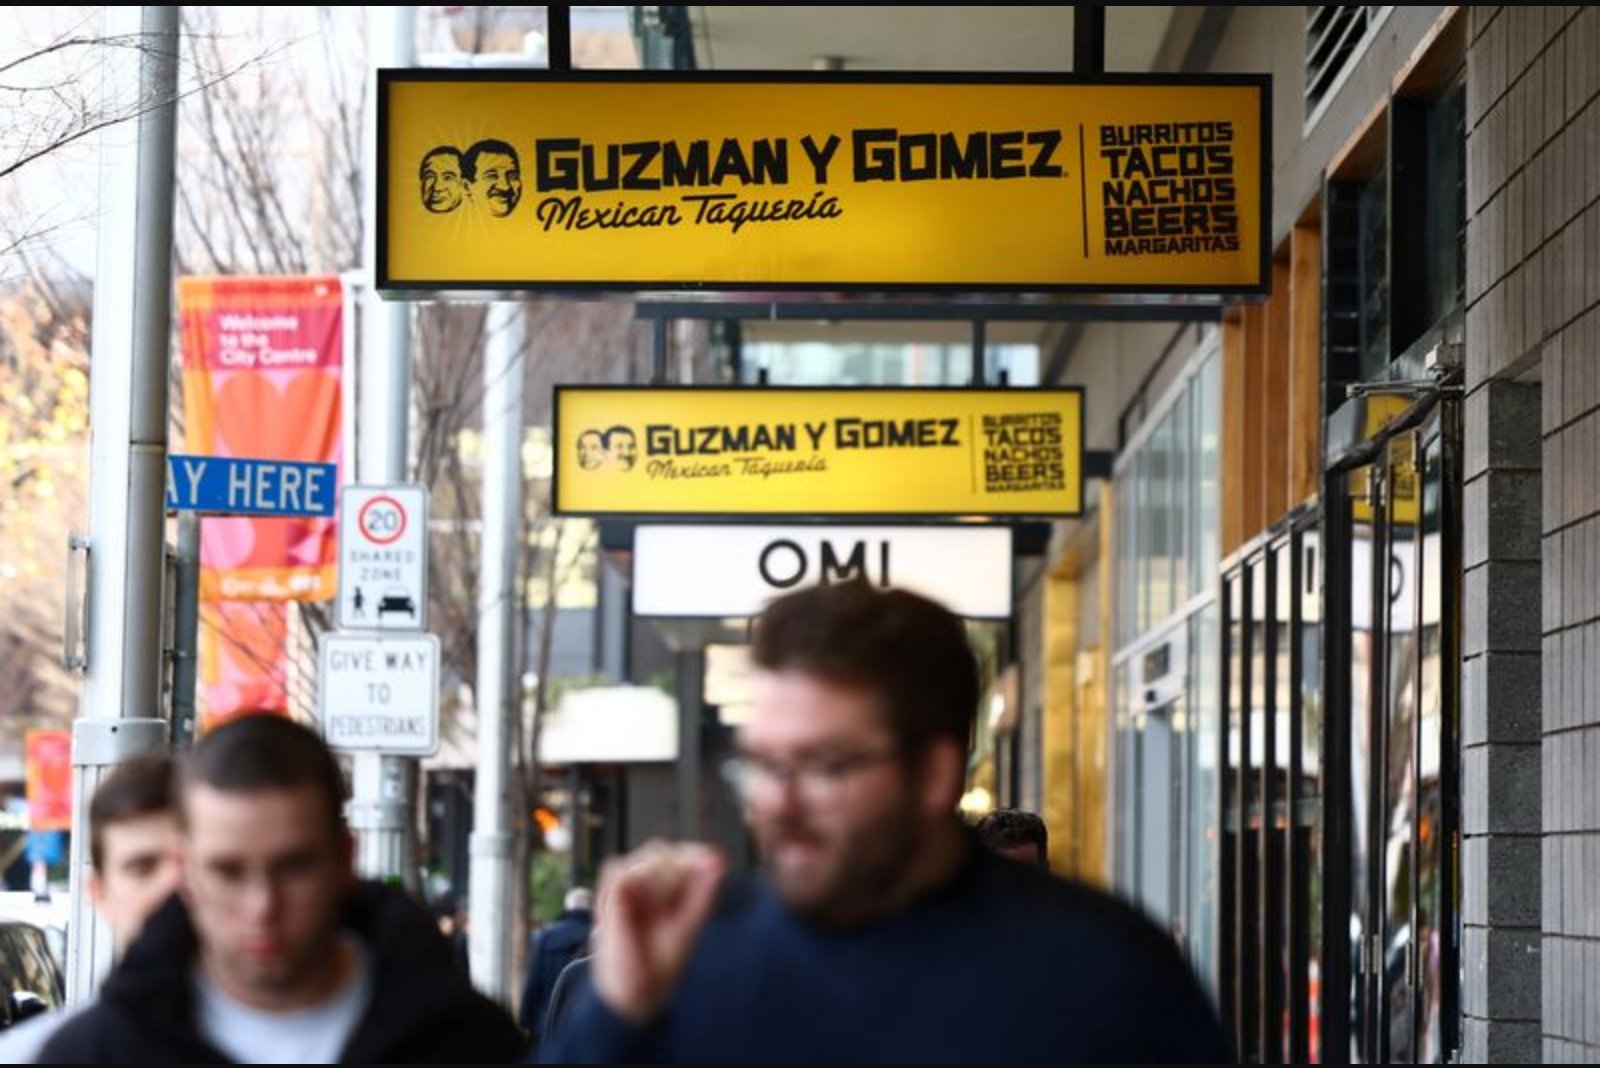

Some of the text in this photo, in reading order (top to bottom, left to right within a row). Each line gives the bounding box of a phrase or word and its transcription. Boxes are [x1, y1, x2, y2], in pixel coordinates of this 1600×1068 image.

[1100, 122, 1233, 146] BURRITOS
[535, 128, 1063, 192] GUZMAN Y GOMEZ
[1101, 145, 1233, 179] TACOS
[1103, 178, 1236, 206] NACHOS
[536, 196, 682, 232] Mexican
[1104, 205, 1239, 238] BEERS
[1104, 235, 1240, 257] MARGARITAS
[220, 314, 298, 331] Welcome
[220, 332, 269, 348] to the
[221, 349, 317, 366] City Centre
[646, 418, 960, 456] GUZMAN Y GOMEZ
[983, 427, 1063, 447] TACOS
[984, 447, 1064, 464] NACHOS
[985, 463, 1065, 482] BEERS
[228, 463, 325, 511] HERE
[369, 509, 398, 532] 20
[351, 551, 415, 563] SHARED
[361, 567, 401, 581] ZONE
[330, 650, 427, 671] GIVE WAY
[368, 682, 392, 705] TO
[330, 714, 426, 737] PEDESTRIANS
